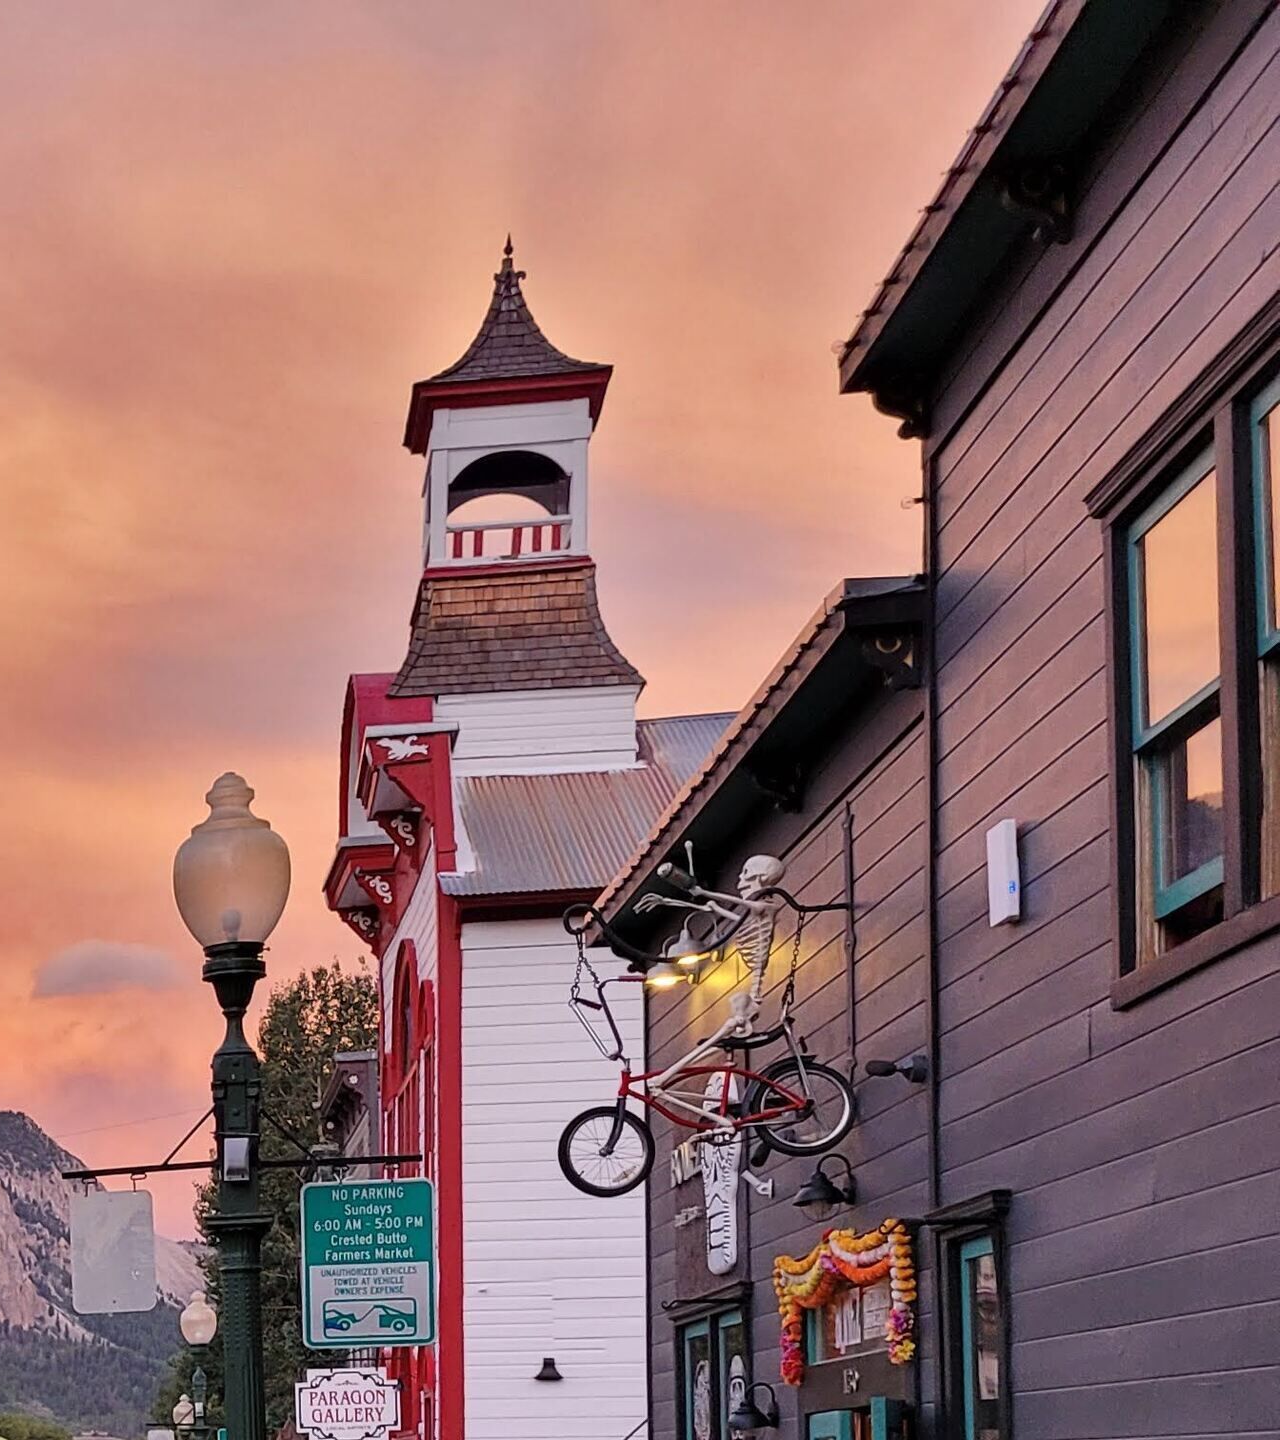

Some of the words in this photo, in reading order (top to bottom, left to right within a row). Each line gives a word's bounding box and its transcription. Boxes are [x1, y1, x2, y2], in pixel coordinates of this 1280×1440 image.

[331, 1189, 348, 1201] NO
[352, 1187, 404, 1200] PARKING
[344, 1204, 392, 1217] Sundays
[313, 1219, 341, 1232] 6:00
[345, 1219, 362, 1230] AM
[374, 1217, 401, 1230] 5:00
[405, 1216, 423, 1228] PM
[331, 1234, 372, 1246] Crested
[377, 1233, 407, 1244] Butte
[325, 1250, 371, 1261] Farmers
[375, 1248, 413, 1260] Market
[321, 1269, 378, 1277] UNAUTHORIZED
[381, 1267, 417, 1275] VEHICLES
[333, 1277, 358, 1287] TOWED
[361, 1277, 371, 1286] AT
[372, 1275, 405, 1286] VEHICLE
[370, 1285, 405, 1296] EXPENSE
[309, 1390, 386, 1406] PARAGON
[312, 1407, 384, 1423] GALLERY
